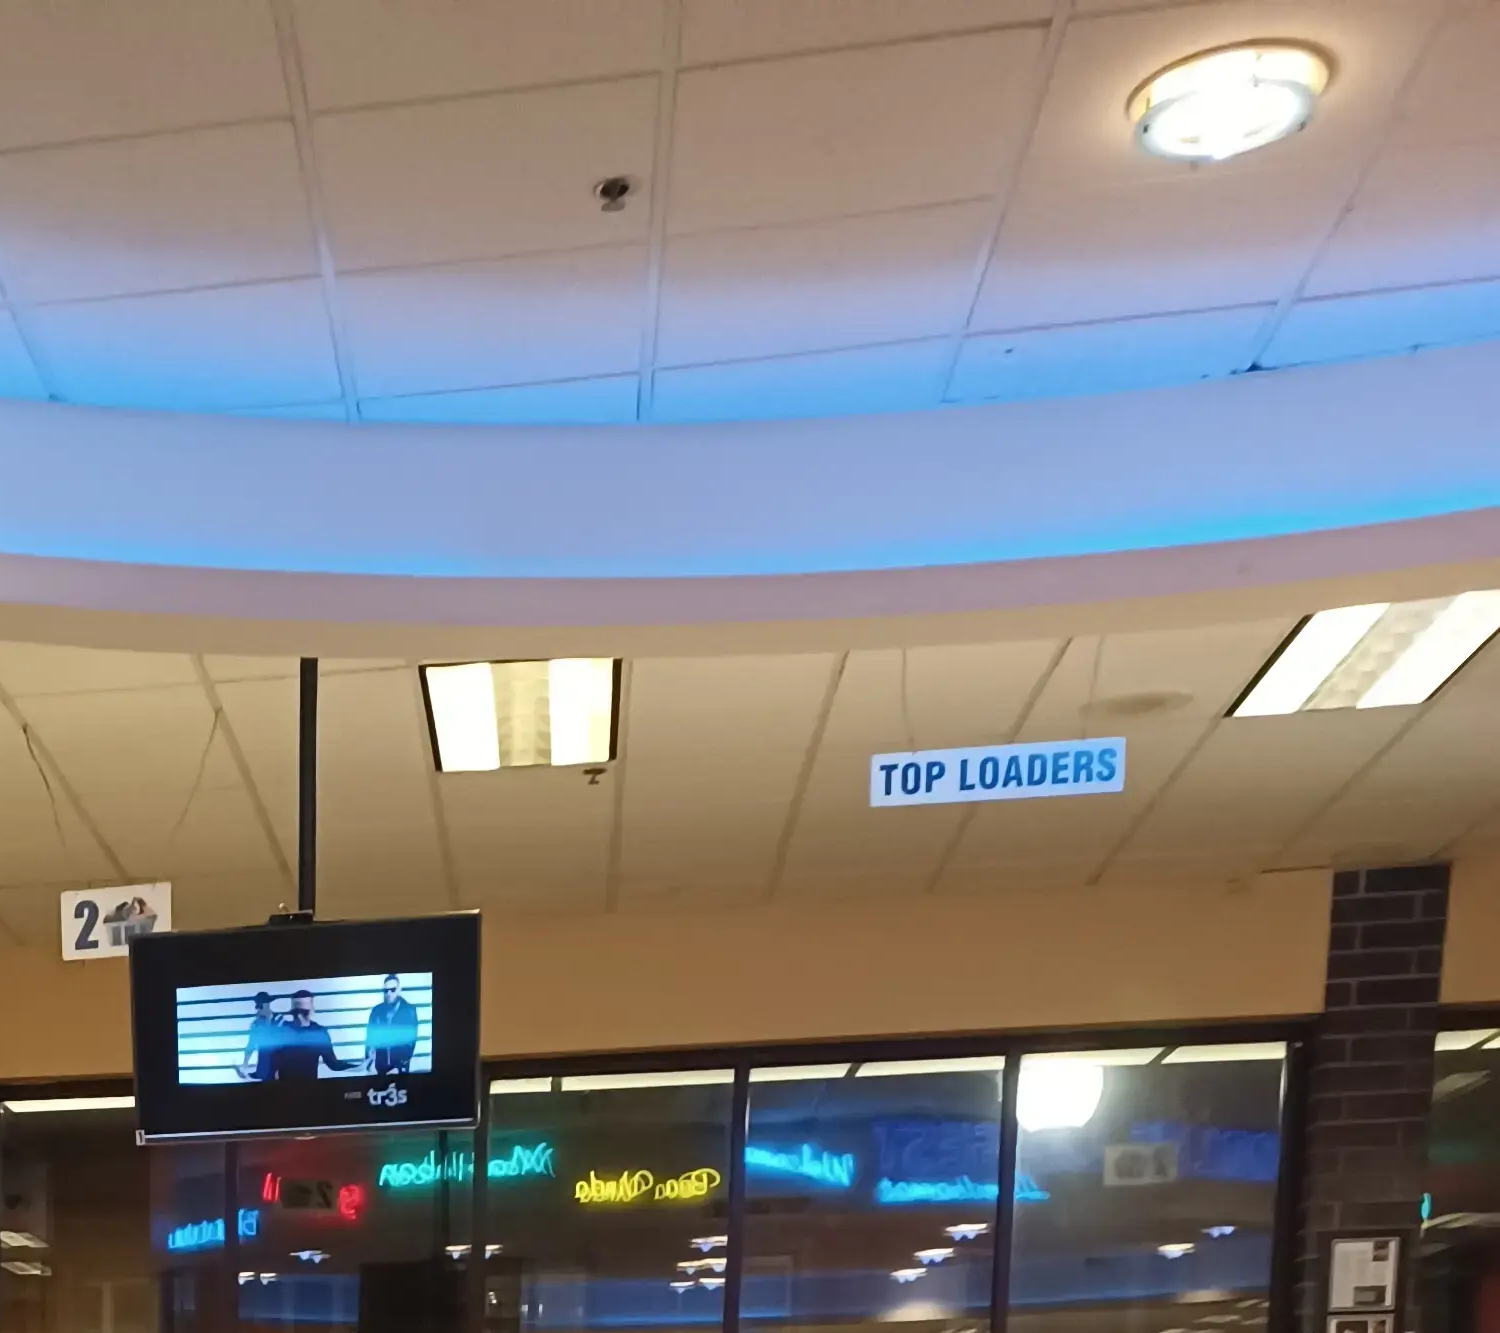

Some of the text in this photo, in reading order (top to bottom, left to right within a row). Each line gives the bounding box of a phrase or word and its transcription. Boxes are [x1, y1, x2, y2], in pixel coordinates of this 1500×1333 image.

[879, 748, 1118, 796] TOP LOADERS
[74, 900, 99, 950] 2
